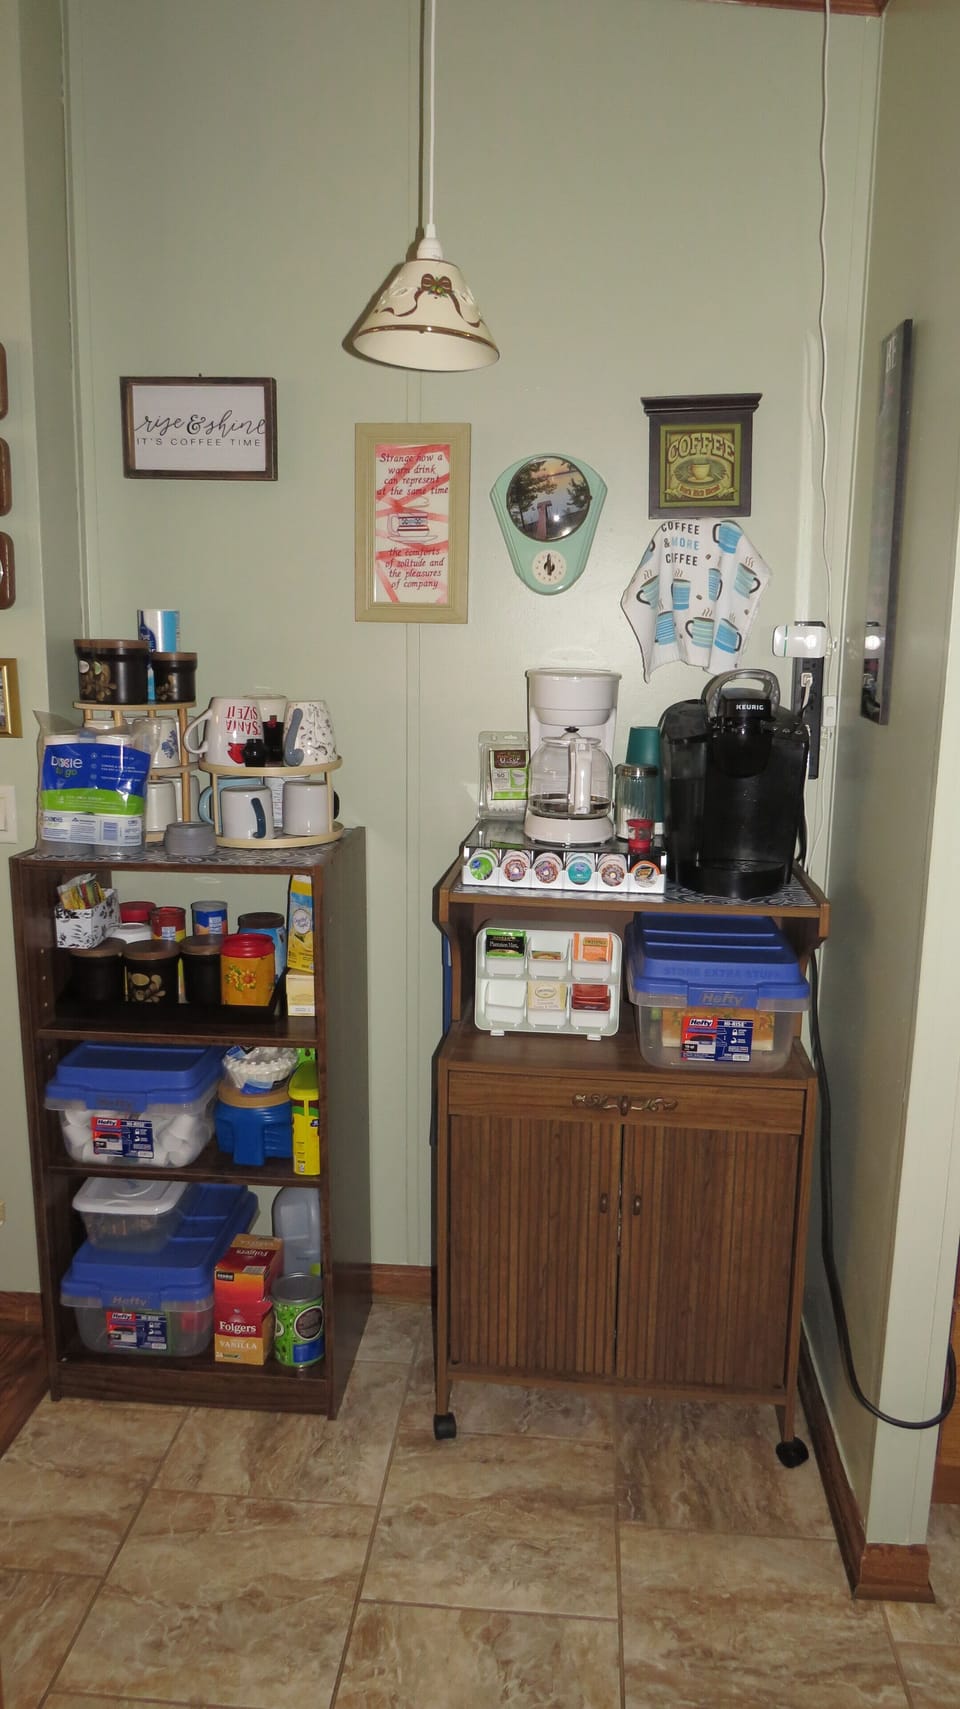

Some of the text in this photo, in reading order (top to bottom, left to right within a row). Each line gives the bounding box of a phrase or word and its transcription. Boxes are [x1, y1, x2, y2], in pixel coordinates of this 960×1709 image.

[170, 438, 222, 446] COFFEE
[231, 438, 262, 446] TIME
[668, 432, 735, 463] COFFEE
[380, 453, 413, 465] Strange
[414, 464, 436, 474] drink
[402, 476, 439, 487] represent
[390, 486, 403, 495] the
[431, 487, 449, 495] time
[661, 521, 700, 535] COFFEE
[389, 547, 440, 558] the comforts
[385, 557, 445, 569] of solitude and
[389, 568, 442, 580] the pleasures
[391, 580, 439, 590] of company
[225, 720, 259, 736] SANTA
[703, 991, 743, 1006] Hefty
[689, 1019, 713, 1027] Hefty
[112, 1312, 132, 1320] Hefty
[219, 1320, 257, 1335] Folgers
[219, 1340, 257, 1350] VANILLA
